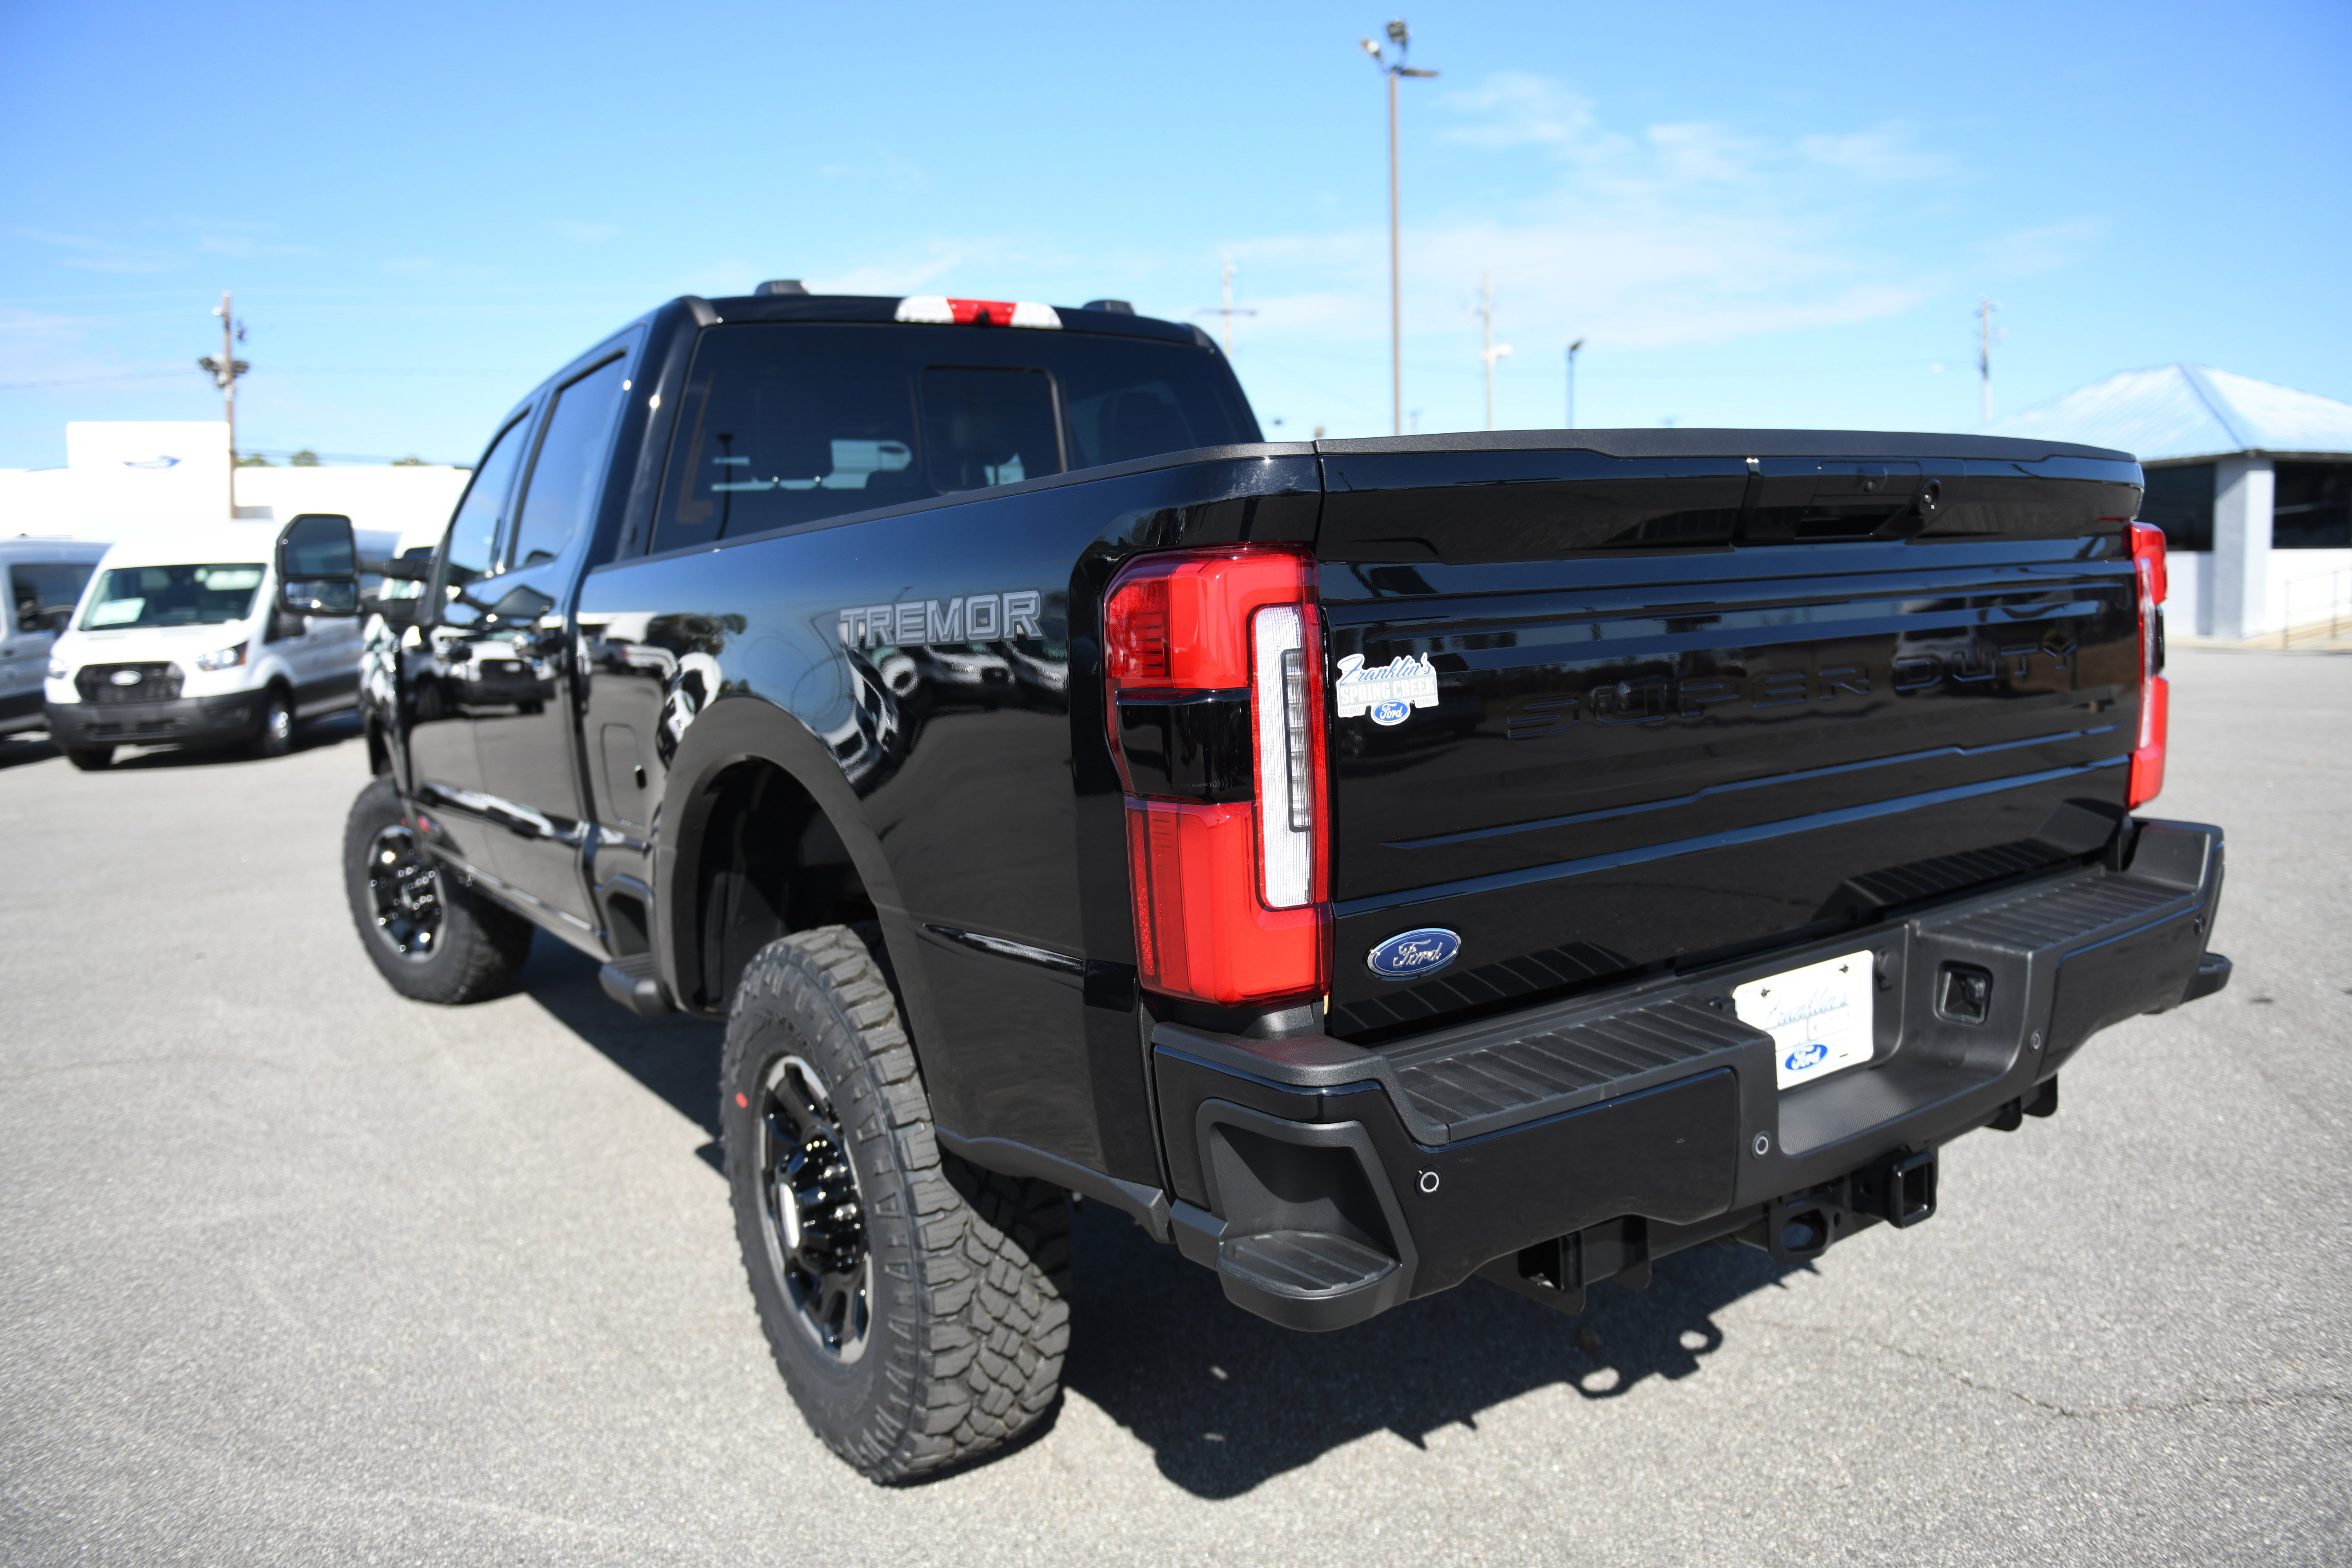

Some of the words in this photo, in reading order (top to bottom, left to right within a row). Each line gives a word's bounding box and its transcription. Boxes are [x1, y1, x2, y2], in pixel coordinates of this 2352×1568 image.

[840, 588, 1046, 649] TREMOR
[1339, 655, 1434, 686] Franklin's
[1340, 681, 1390, 704] SPRING
[1393, 676, 1435, 698] CREEK
[1417, 697, 1437, 706] GEORGIA
[1507, 666, 1870, 738] SUPER
[1893, 643, 2078, 691] DUTY
[1339, 706, 1365, 715] COLQUITT
[1380, 702, 1403, 719] Ford
[1393, 939, 1443, 968] Ford
[1763, 987, 1847, 1030] Franklins
[1791, 1044, 1821, 1070] Ford
